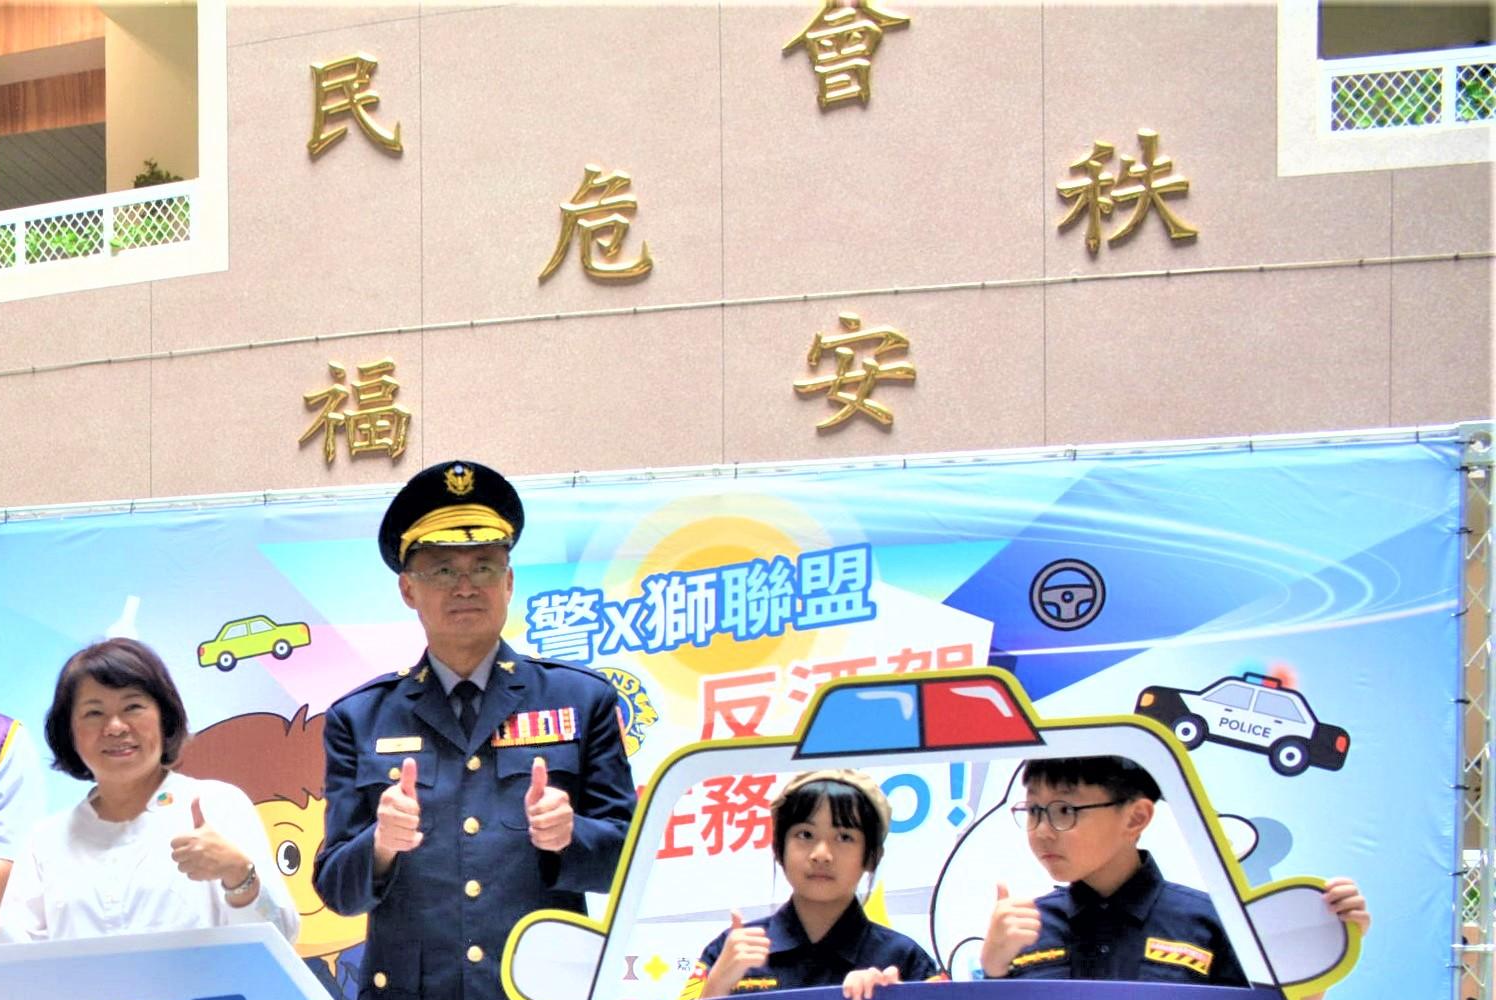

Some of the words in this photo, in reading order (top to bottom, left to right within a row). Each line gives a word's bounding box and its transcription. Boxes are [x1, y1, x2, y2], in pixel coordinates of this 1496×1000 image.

[540, 165, 652, 281] 危
[1055, 129, 1199, 256] 秩
[1218, 716, 1271, 738] POLICE
